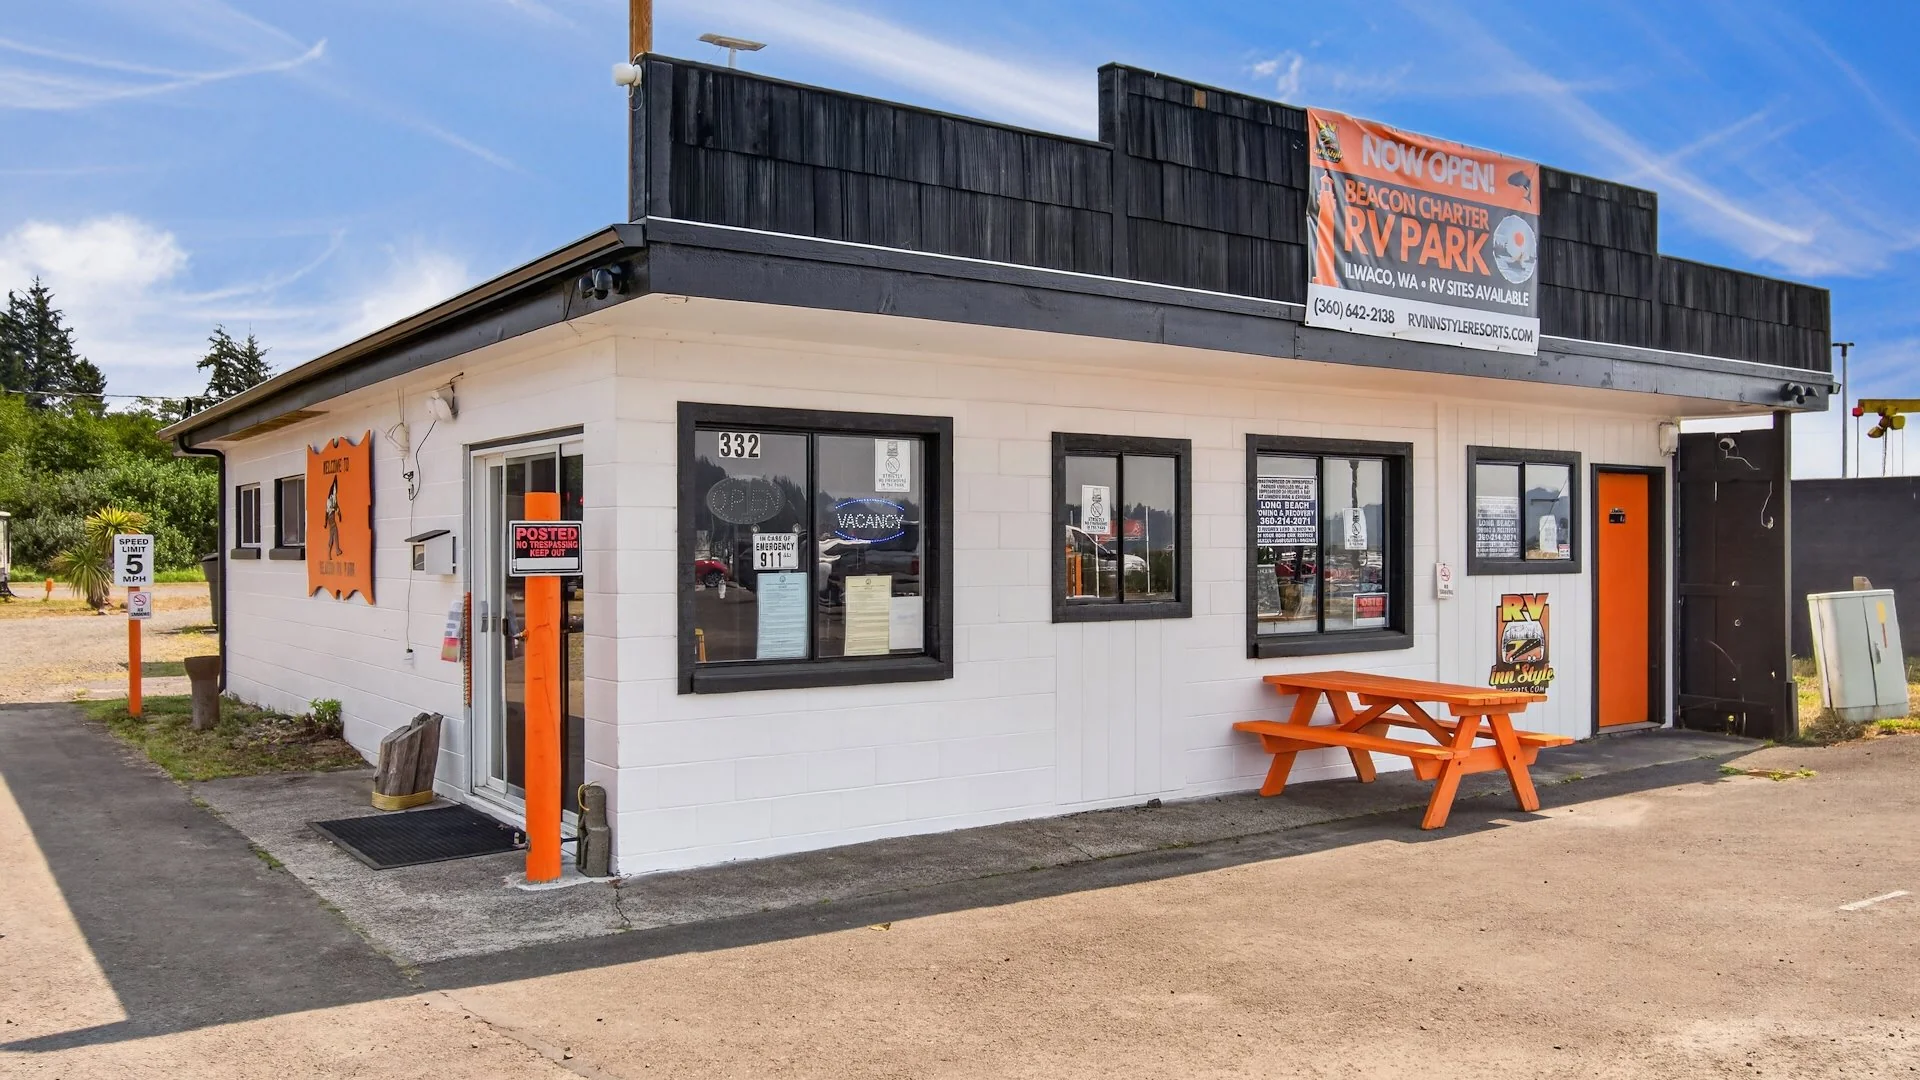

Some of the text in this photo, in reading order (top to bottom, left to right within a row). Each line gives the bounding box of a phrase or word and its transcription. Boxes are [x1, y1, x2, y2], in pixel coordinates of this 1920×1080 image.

[1362, 134, 1496, 194] NOW OPEN!
[1345, 179, 1490, 230] BEACON CHARTER
[1344, 206, 1492, 276] RV PARK
[1345, 262, 1529, 306] ILWACO, WA RV SITES AVAILABLE
[1314, 297, 1395, 324] (360) 642-2138
[1408, 313, 1533, 343] RVINNSTYLERESORTS.COM
[720, 433, 759, 458] 332
[343, 457, 350, 472] TO
[712, 489, 781, 514] OPEN
[1260, 501, 1310, 509] LONG BEACH
[837, 513, 904, 529] VACANCY
[1259, 517, 1311, 525] 360-214-2071
[516, 527, 578, 541] POSTED
[516, 541, 578, 549] NO TRESPASSING
[529, 549, 566, 557] KEEP OUT
[756, 542, 795, 551] EMERGENCY
[125, 554, 144, 575] 5
[760, 552, 782, 567] 911
[1501, 593, 1549, 622] RV
[1517, 664, 1555, 687] Style
